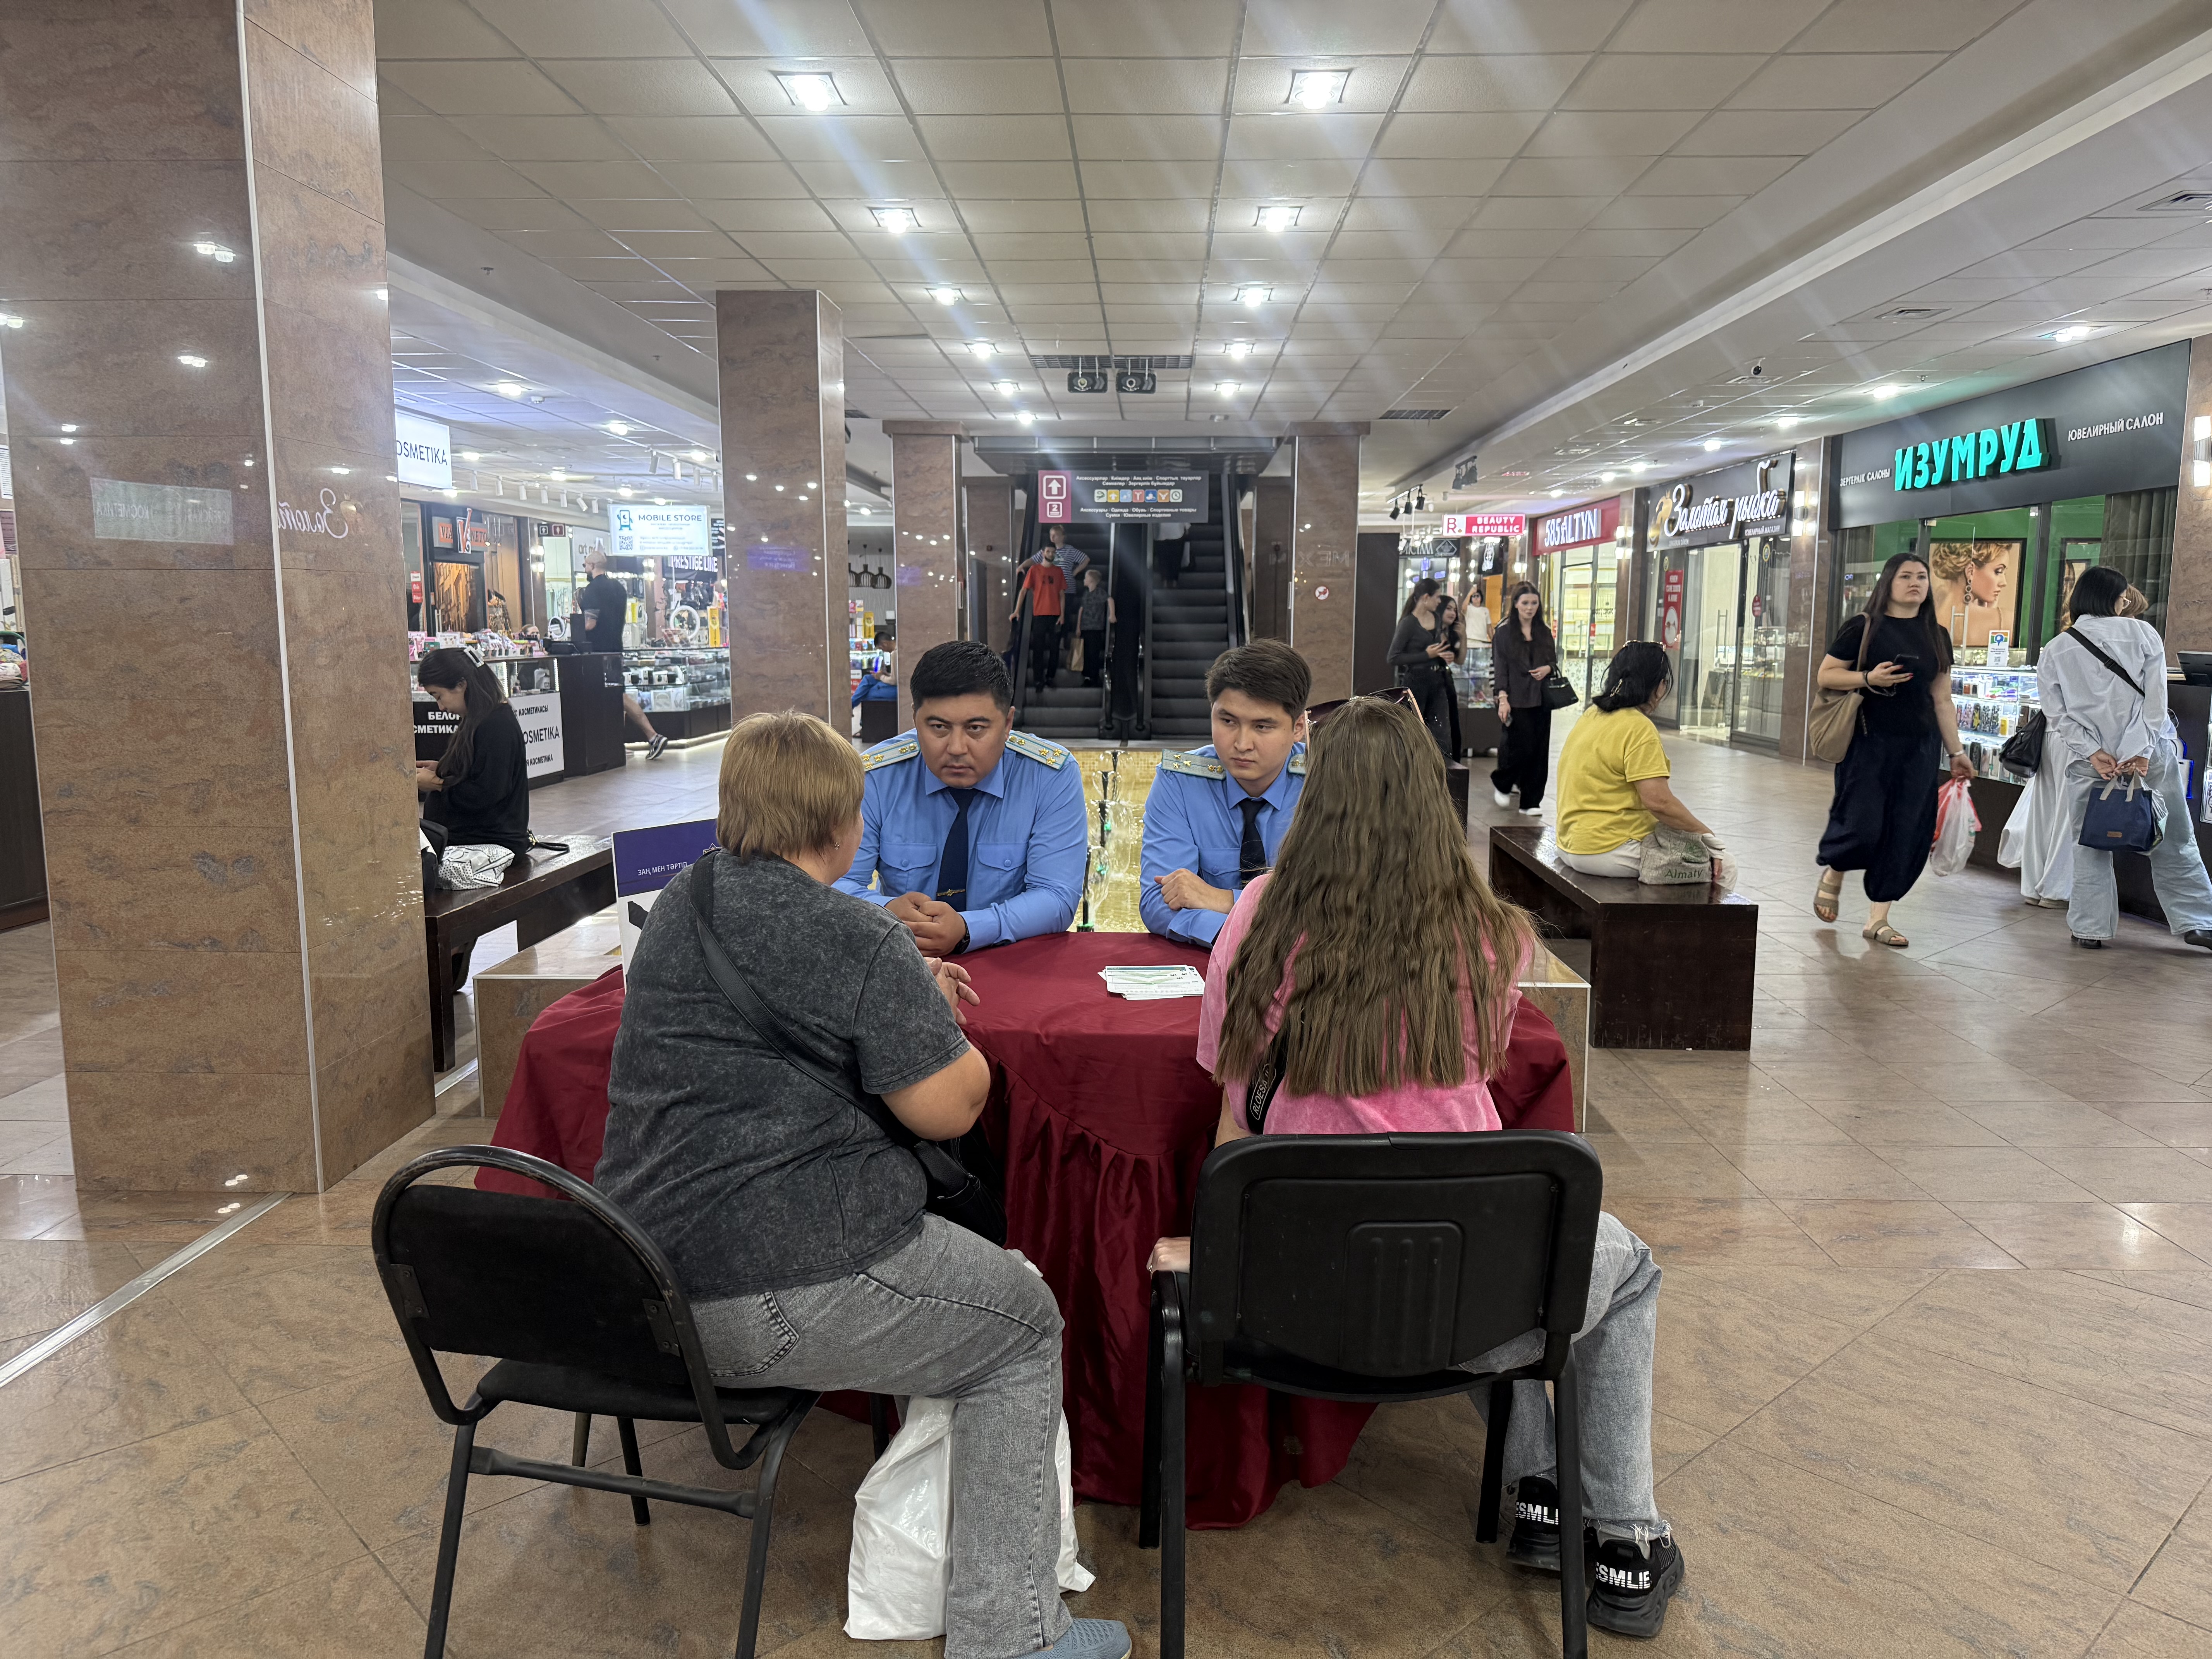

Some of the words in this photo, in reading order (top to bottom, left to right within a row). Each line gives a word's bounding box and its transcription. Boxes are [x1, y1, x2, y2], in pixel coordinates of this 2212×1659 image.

[2068, 418, 2124, 441] ЮВЕЛИРНЫЙ
[2126, 412, 2164, 430] САЛОН
[1894, 418, 2042, 491] ИЗУМРУД
[1840, 473, 1865, 487] ЗЕРГЕРЛІК
[1867, 468, 1891, 481] САЛОНЫ
[1664, 484, 1729, 537] Золотая
[1729, 460, 1781, 539] рыбка
[441, 526, 452, 539] VIA
[673, 556, 703, 570] PRESTIGE
[704, 556, 718, 572] LINE
[519, 705, 549, 716] КОСМЕТИКАСЫ
[530, 754, 553, 766] КОСМЕТИКА
[666, 862, 687, 870] ТӘРТІП
[1664, 868, 1703, 879] Almaty
